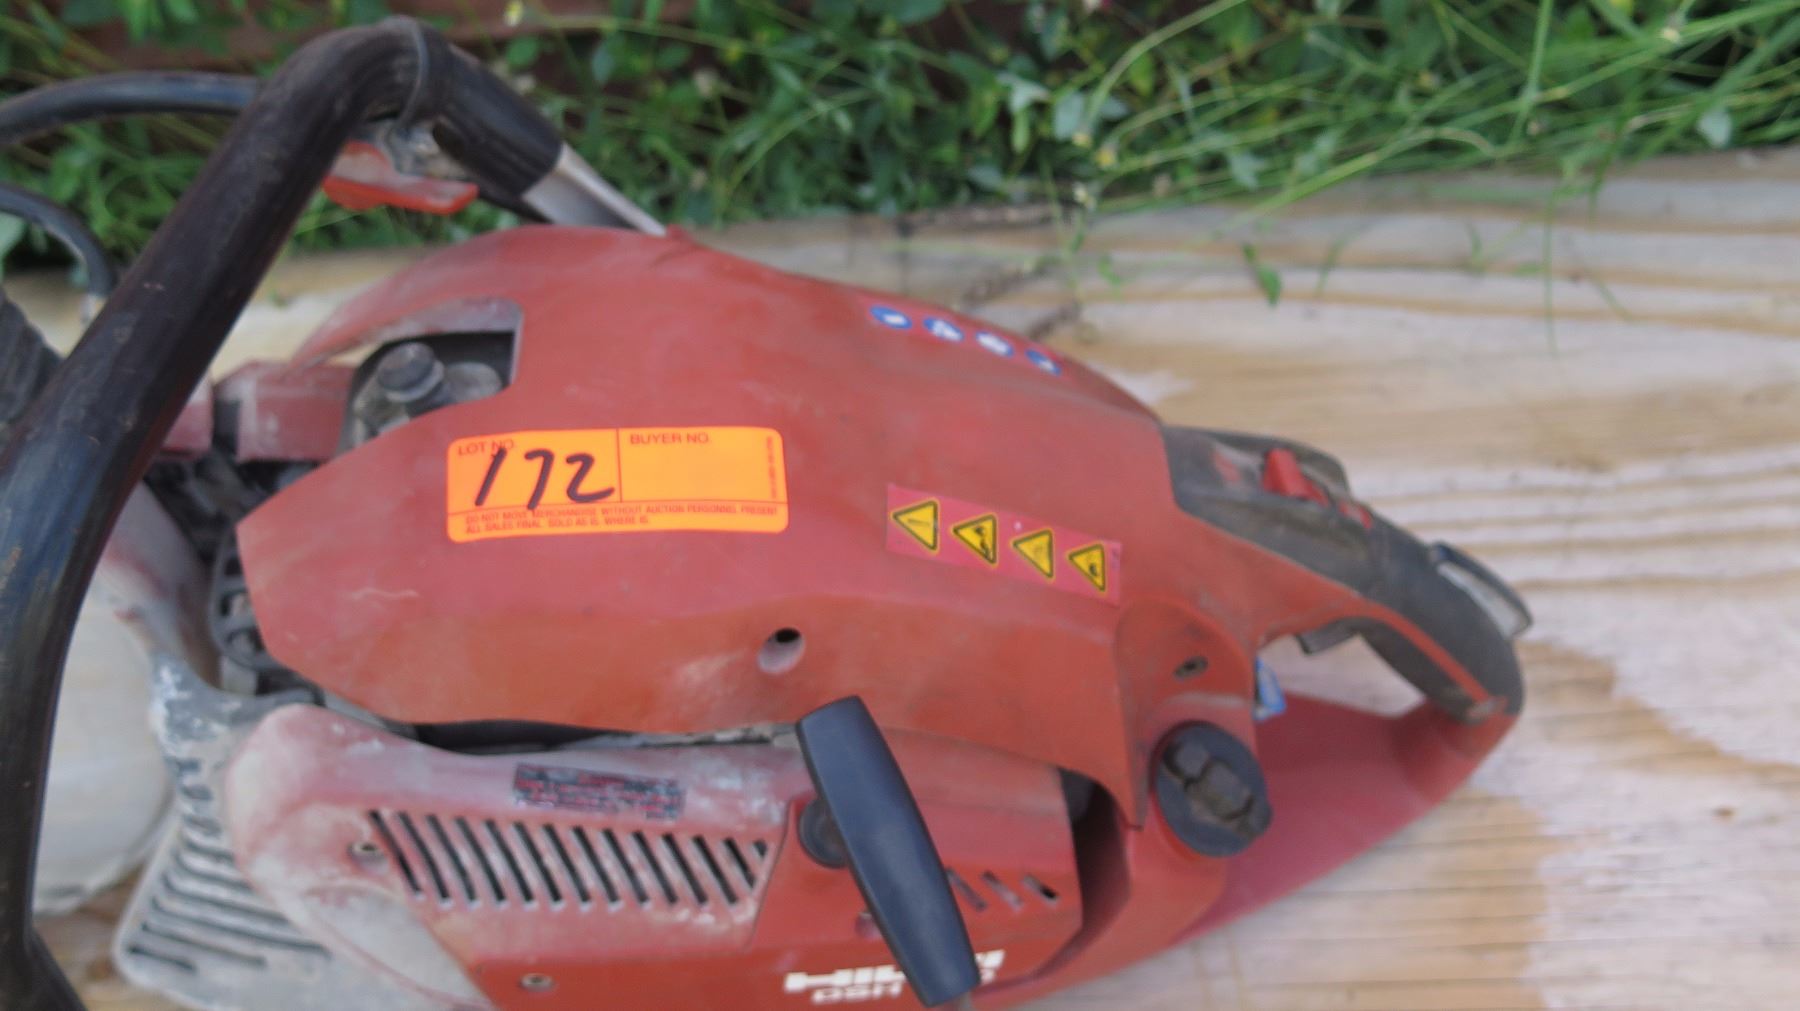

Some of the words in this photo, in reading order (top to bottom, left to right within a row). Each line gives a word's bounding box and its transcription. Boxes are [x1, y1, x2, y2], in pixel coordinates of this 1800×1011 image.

[630, 433, 681, 445] BUYER
[458, 442, 486, 456] LOT
[475, 447, 615, 510] 172
[482, 512, 500, 522] NOT
[503, 511, 527, 520] MOVE
[531, 508, 597, 518] MERCHANDISE
[602, 506, 641, 516] WITHOUT
[646, 504, 684, 514] AUCTION
[740, 505, 777, 516] PRESENT
[466, 525, 481, 535] ALL
[485, 522, 514, 532] SALES
[547, 518, 573, 528] SOLD
[605, 515, 635, 525] WHERE
[784, 948, 1006, 994] HILI
